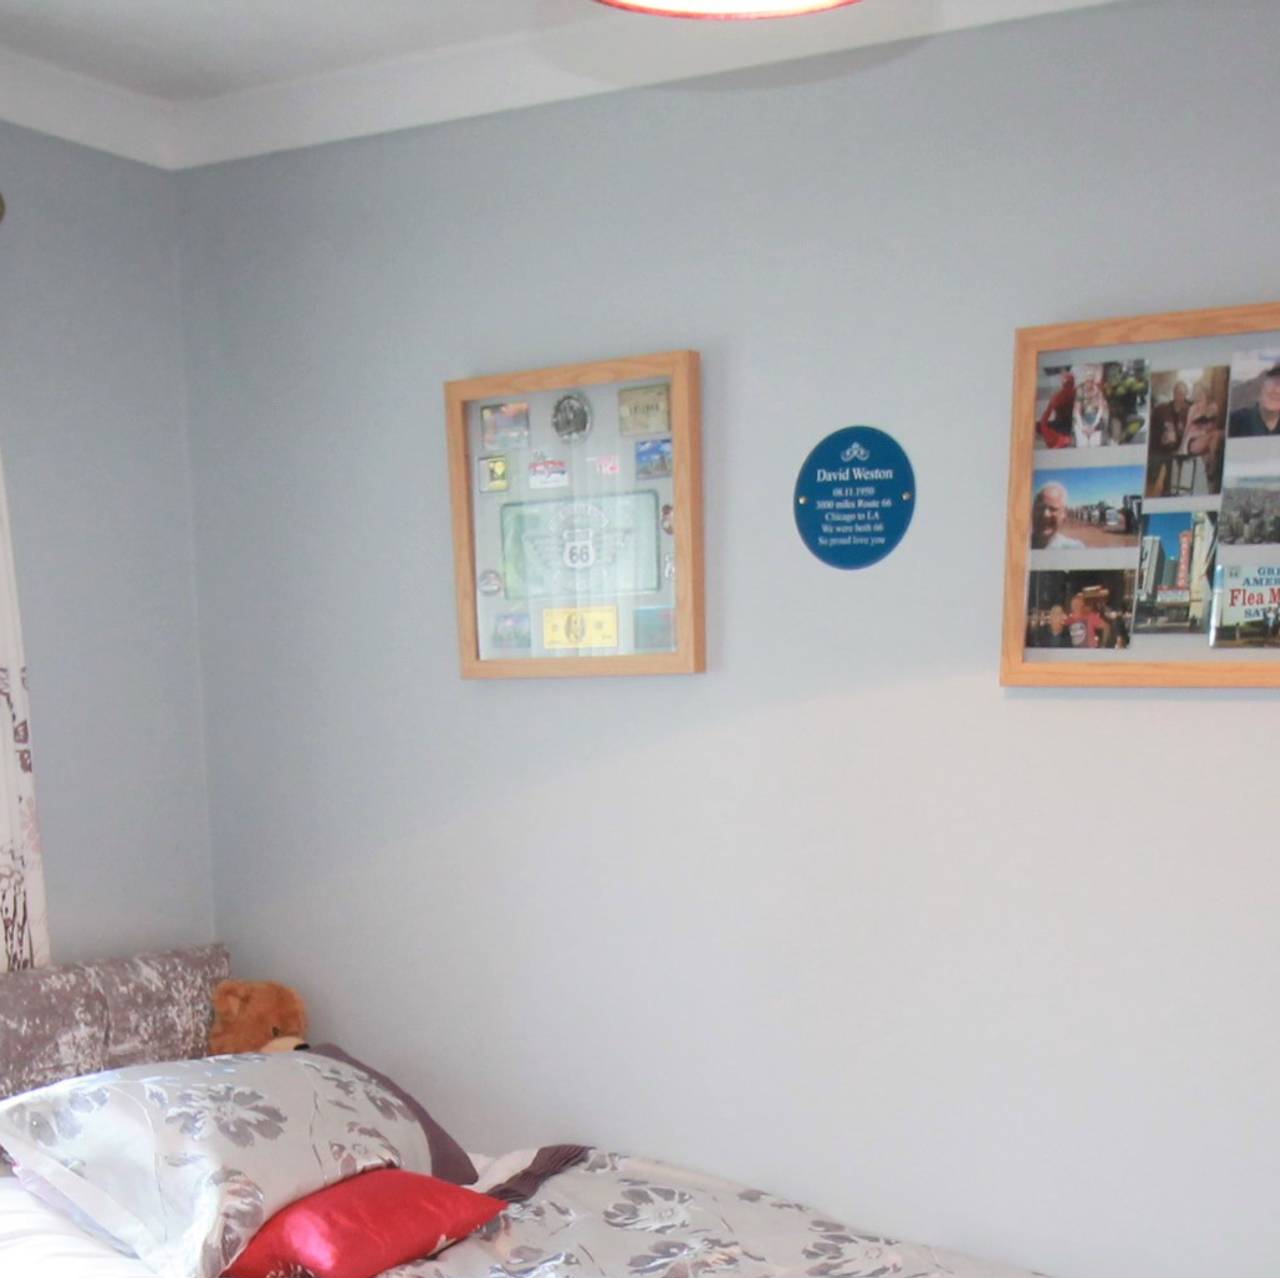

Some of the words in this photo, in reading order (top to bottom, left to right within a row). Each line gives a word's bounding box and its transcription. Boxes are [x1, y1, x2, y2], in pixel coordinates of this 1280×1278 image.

[816, 468, 849, 482] David
[852, 467, 894, 480] Weston
[856, 498, 880, 509] Route
[825, 512, 856, 523] Chicago
[857, 512, 866, 521] to
[1229, 588, 1265, 607] Flea
